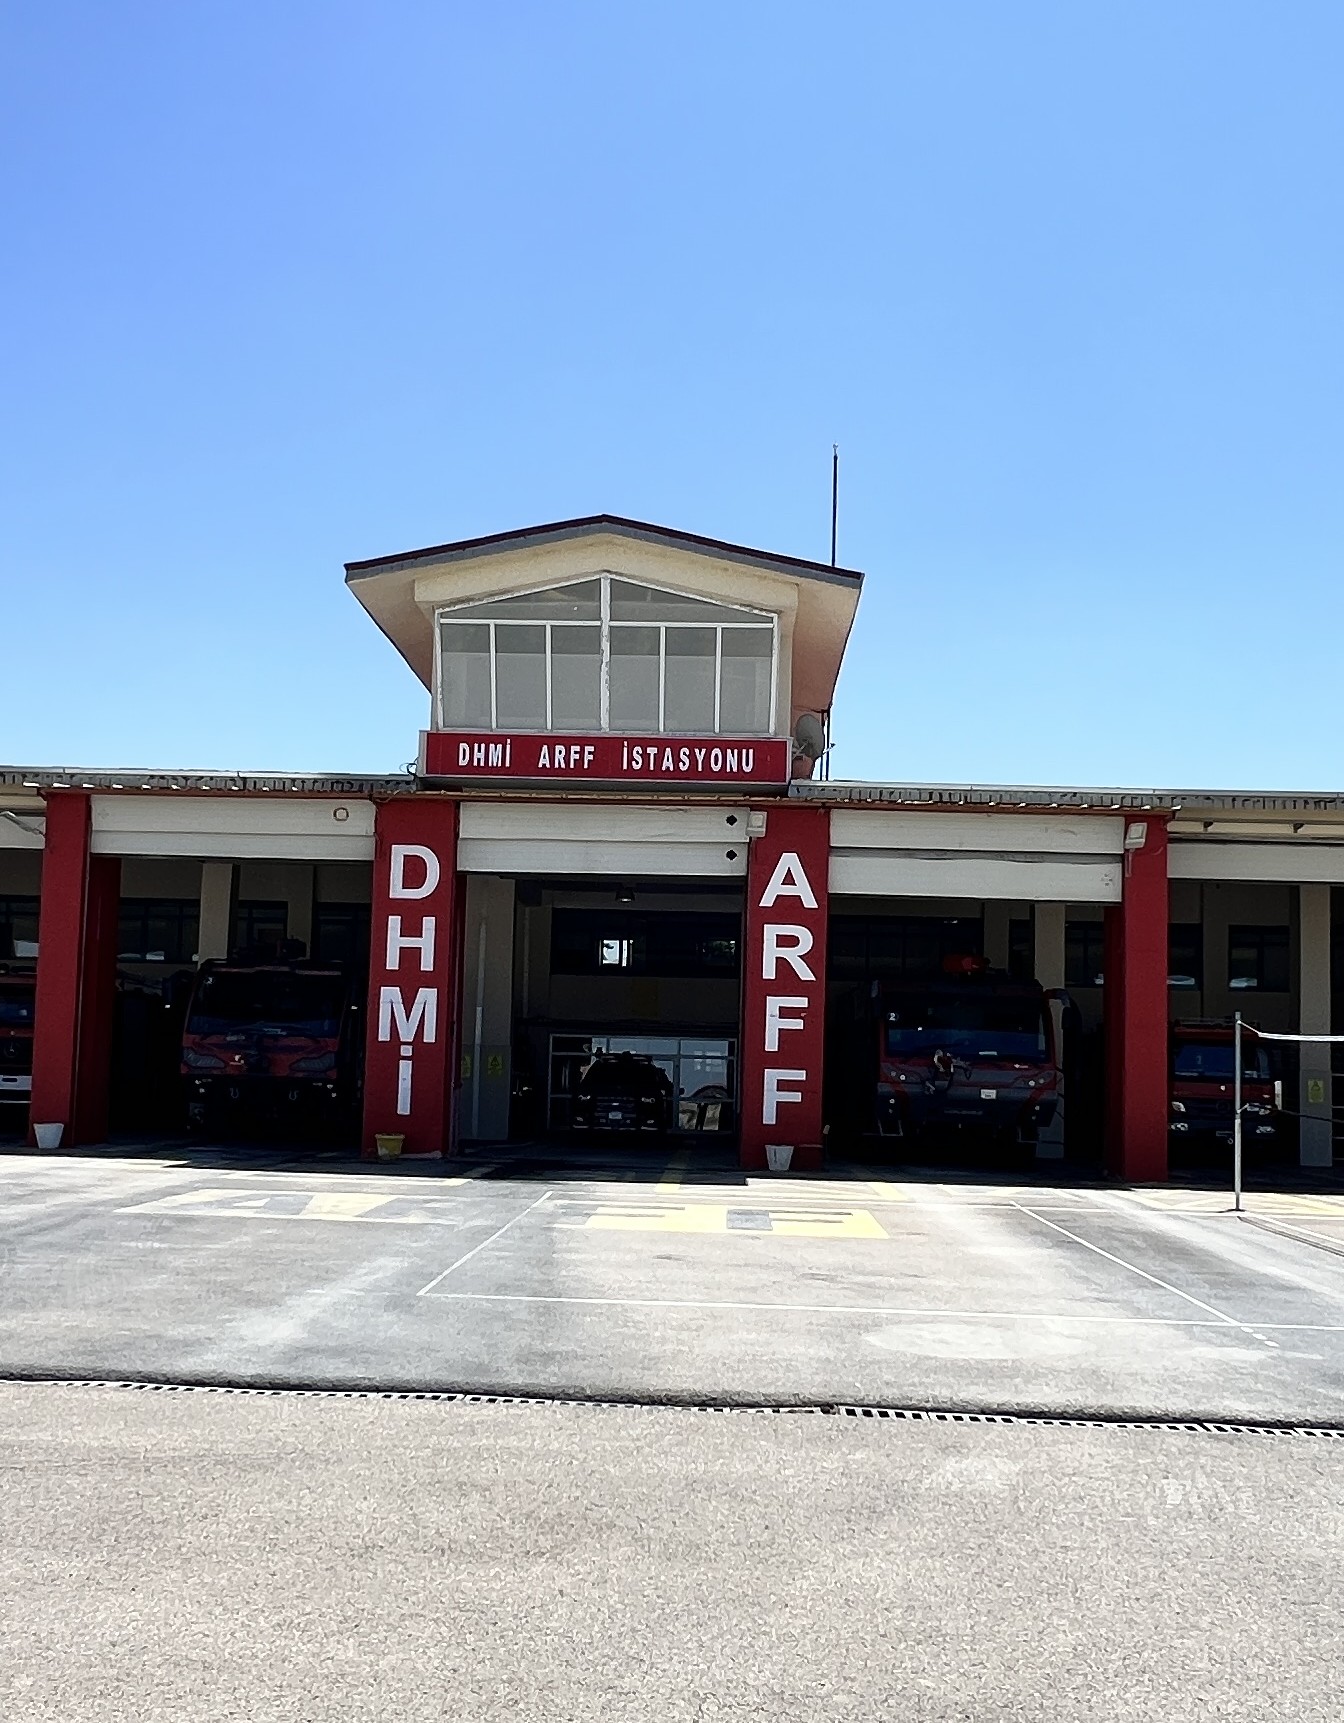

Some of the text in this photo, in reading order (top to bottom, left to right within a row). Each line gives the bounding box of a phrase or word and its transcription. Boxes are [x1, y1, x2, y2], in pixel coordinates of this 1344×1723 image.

[459, 739, 754, 773] DHMİ ARFF İSTASYONU
[758, 852, 818, 1125] ARFF
